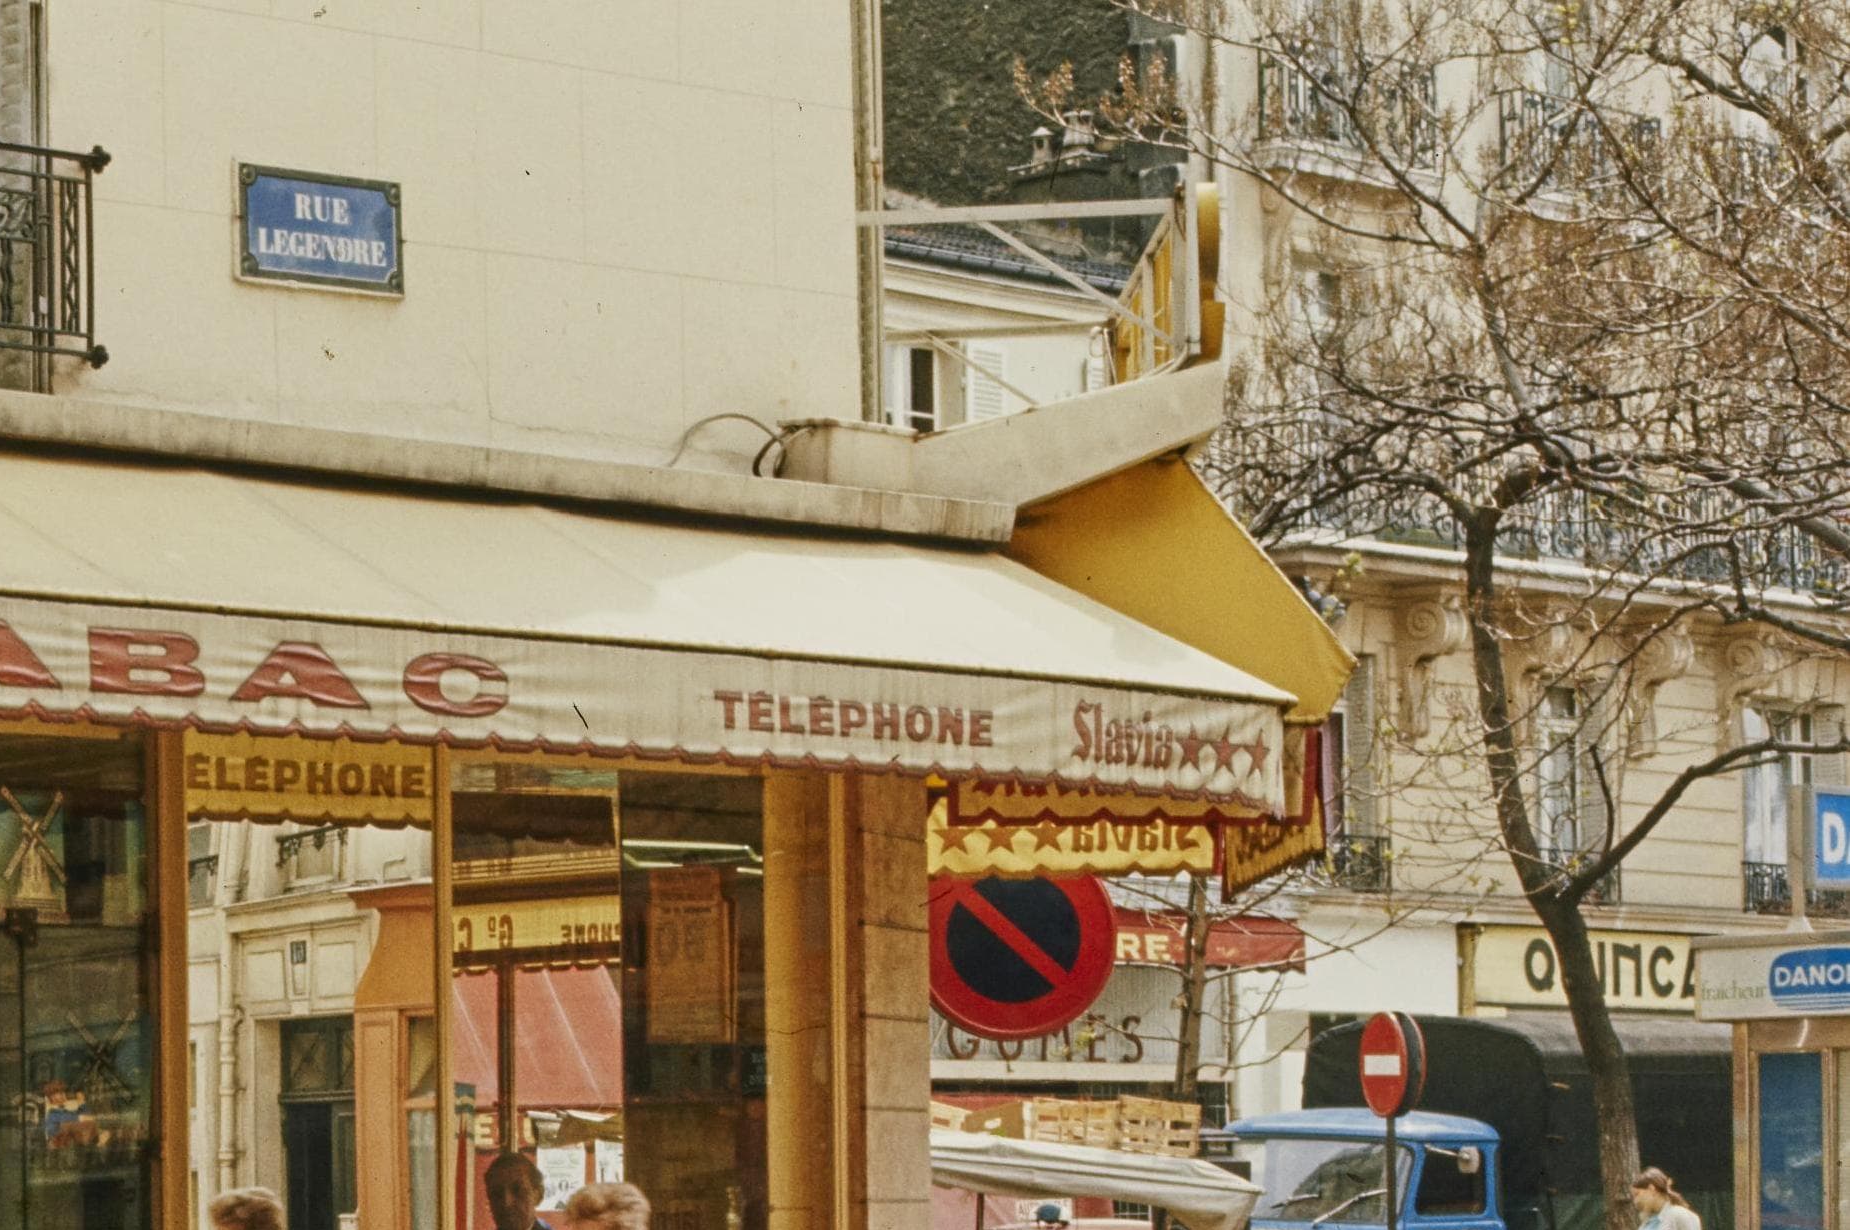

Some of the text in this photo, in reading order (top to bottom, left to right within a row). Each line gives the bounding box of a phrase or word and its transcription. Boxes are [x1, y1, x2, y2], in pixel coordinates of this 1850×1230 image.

[294, 192, 351, 225] RUE
[257, 227, 387, 268] LEGENDRE
[1071, 698, 1174, 770] Slavia
[1774, 964, 1850, 988] DANO
